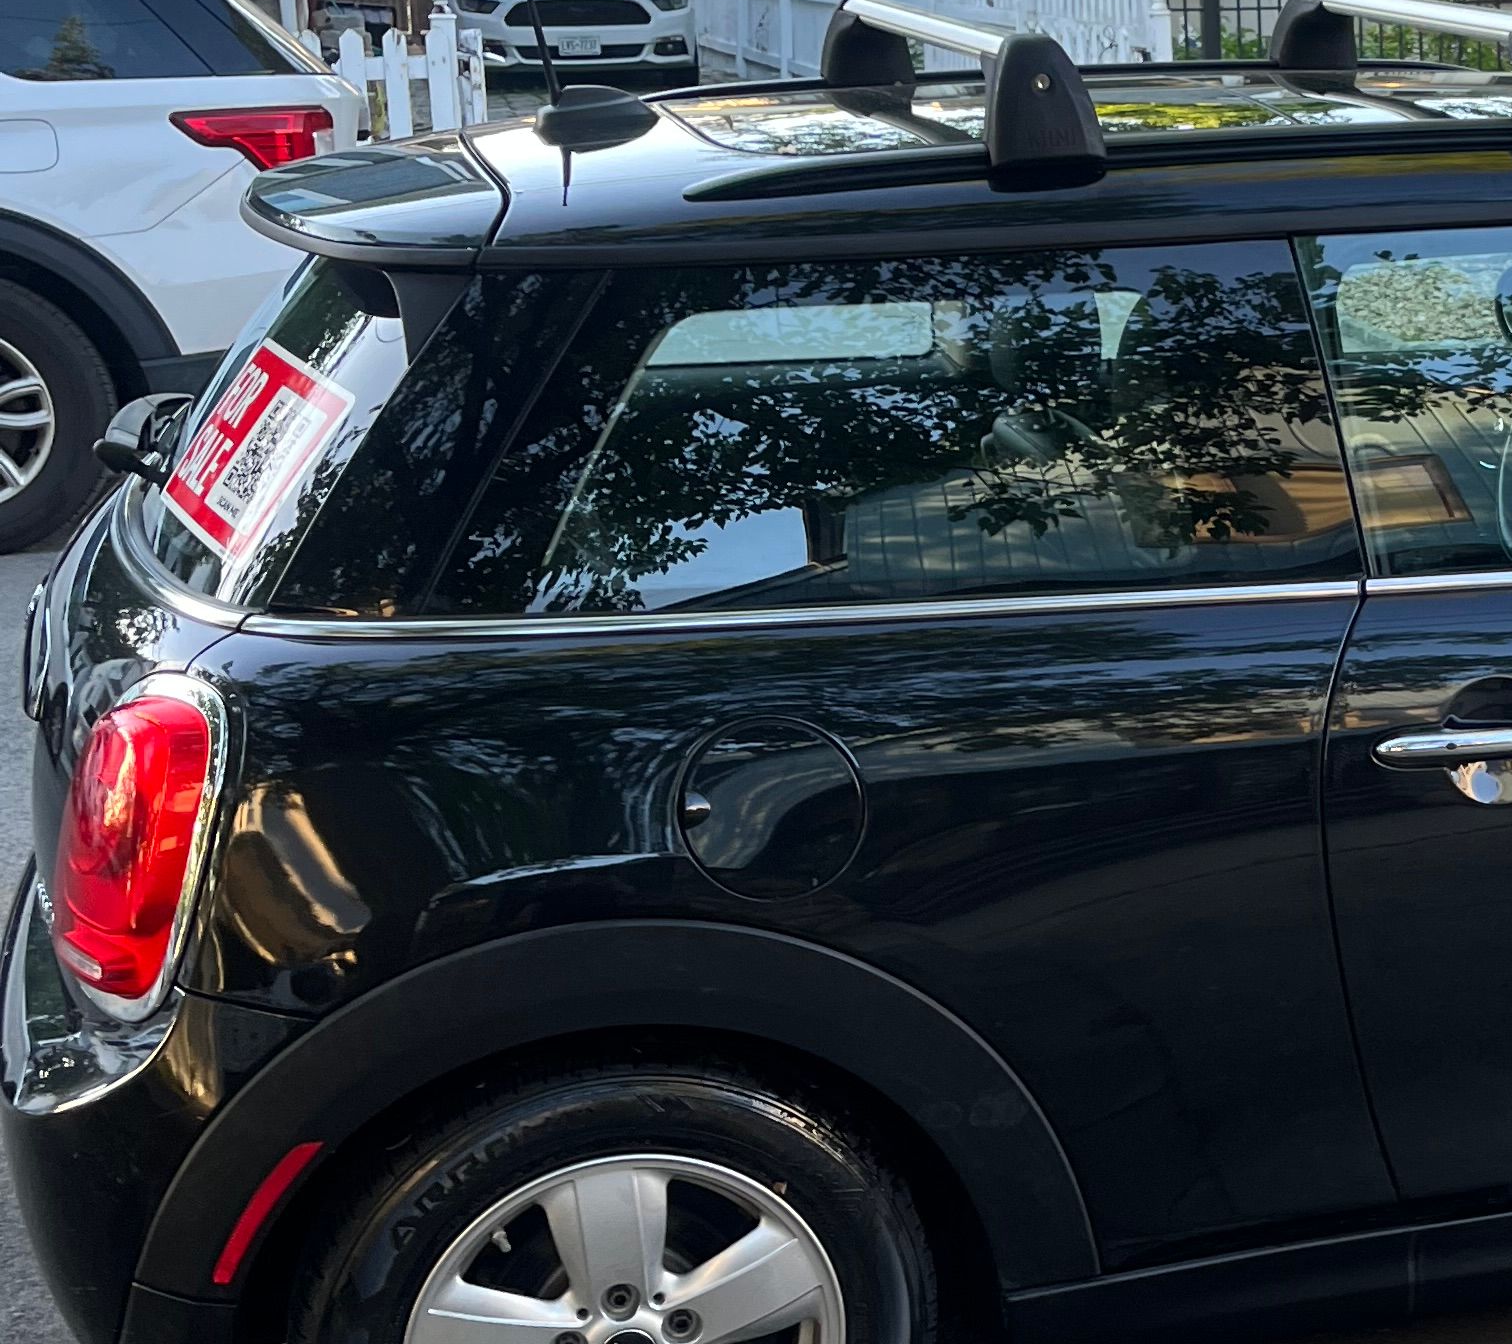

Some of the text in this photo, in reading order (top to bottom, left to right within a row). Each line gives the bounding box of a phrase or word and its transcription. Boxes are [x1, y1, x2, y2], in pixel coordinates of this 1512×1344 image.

[217, 362, 269, 429] FOR
[178, 424, 234, 497] SALE
[217, 496, 231, 511] SCAN
